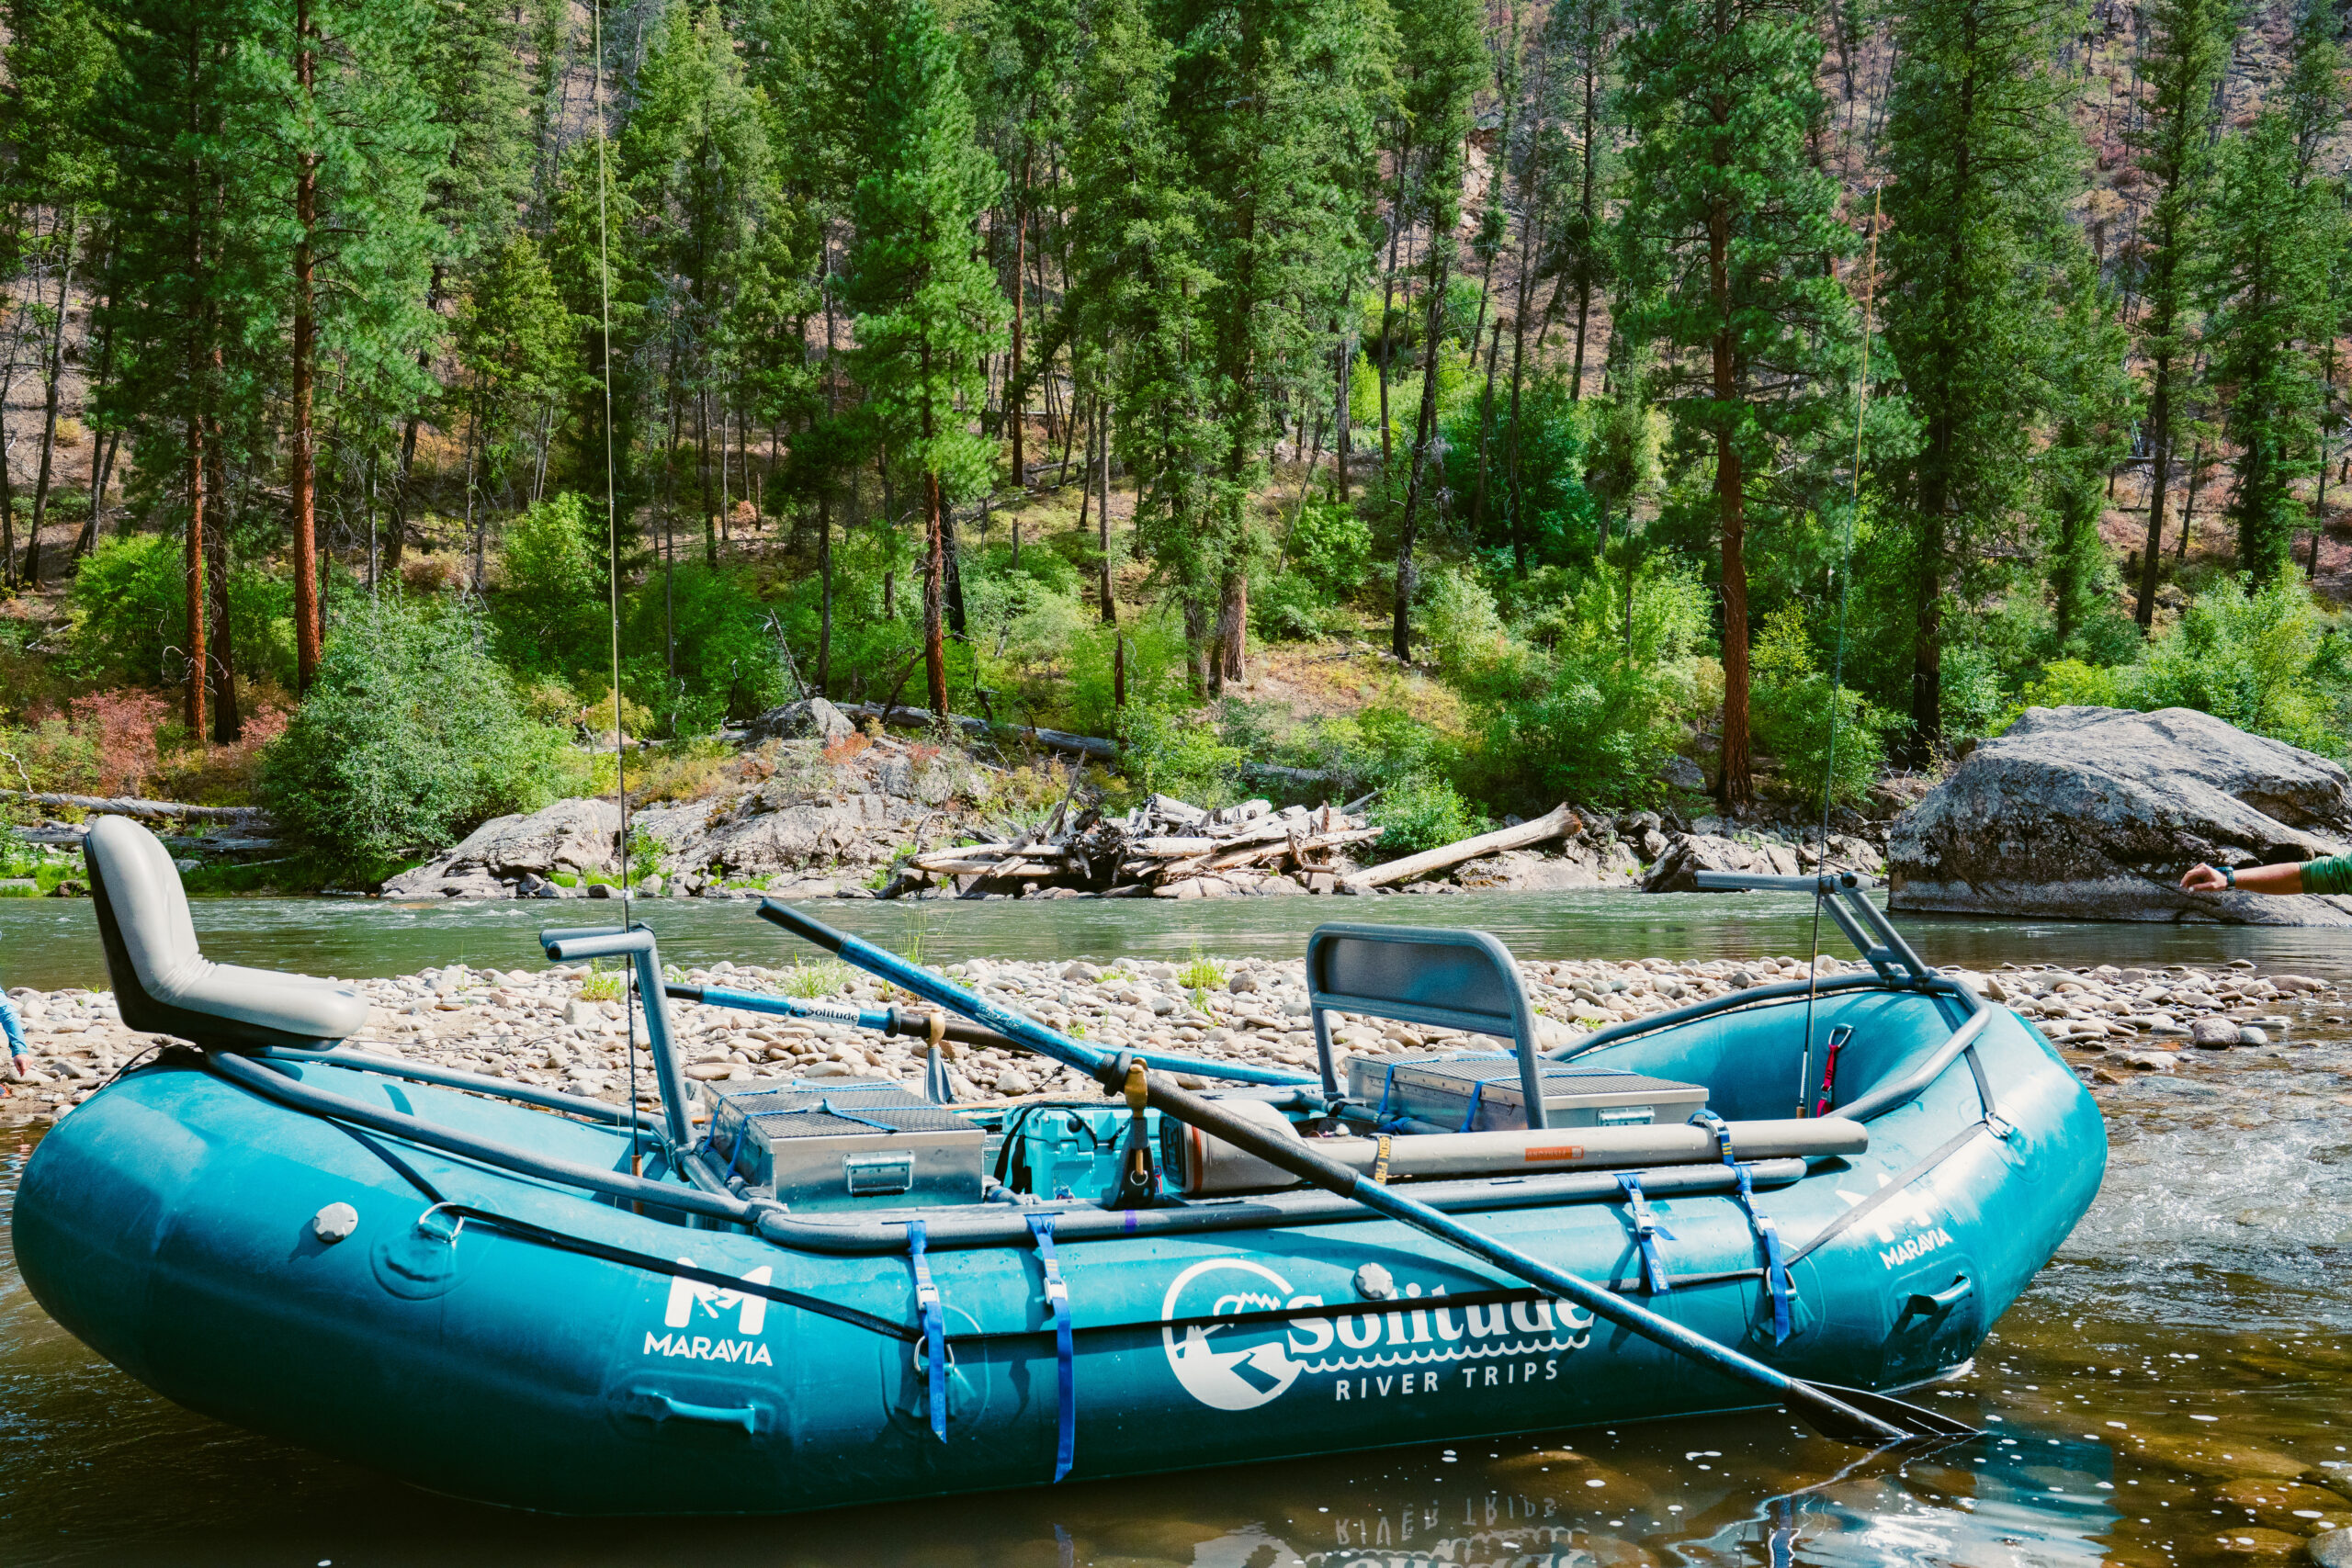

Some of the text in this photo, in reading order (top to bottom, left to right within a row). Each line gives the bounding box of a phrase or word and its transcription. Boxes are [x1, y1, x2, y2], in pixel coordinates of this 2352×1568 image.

[808, 1006, 858, 1022] Solitude
[1879, 1227, 1954, 1270] MARAVIA
[1286, 1282, 1595, 1355] Solitude
[643, 1331, 774, 1367] MARAVIA
[1336, 1359, 1558, 1402] RIVER TRIPS
